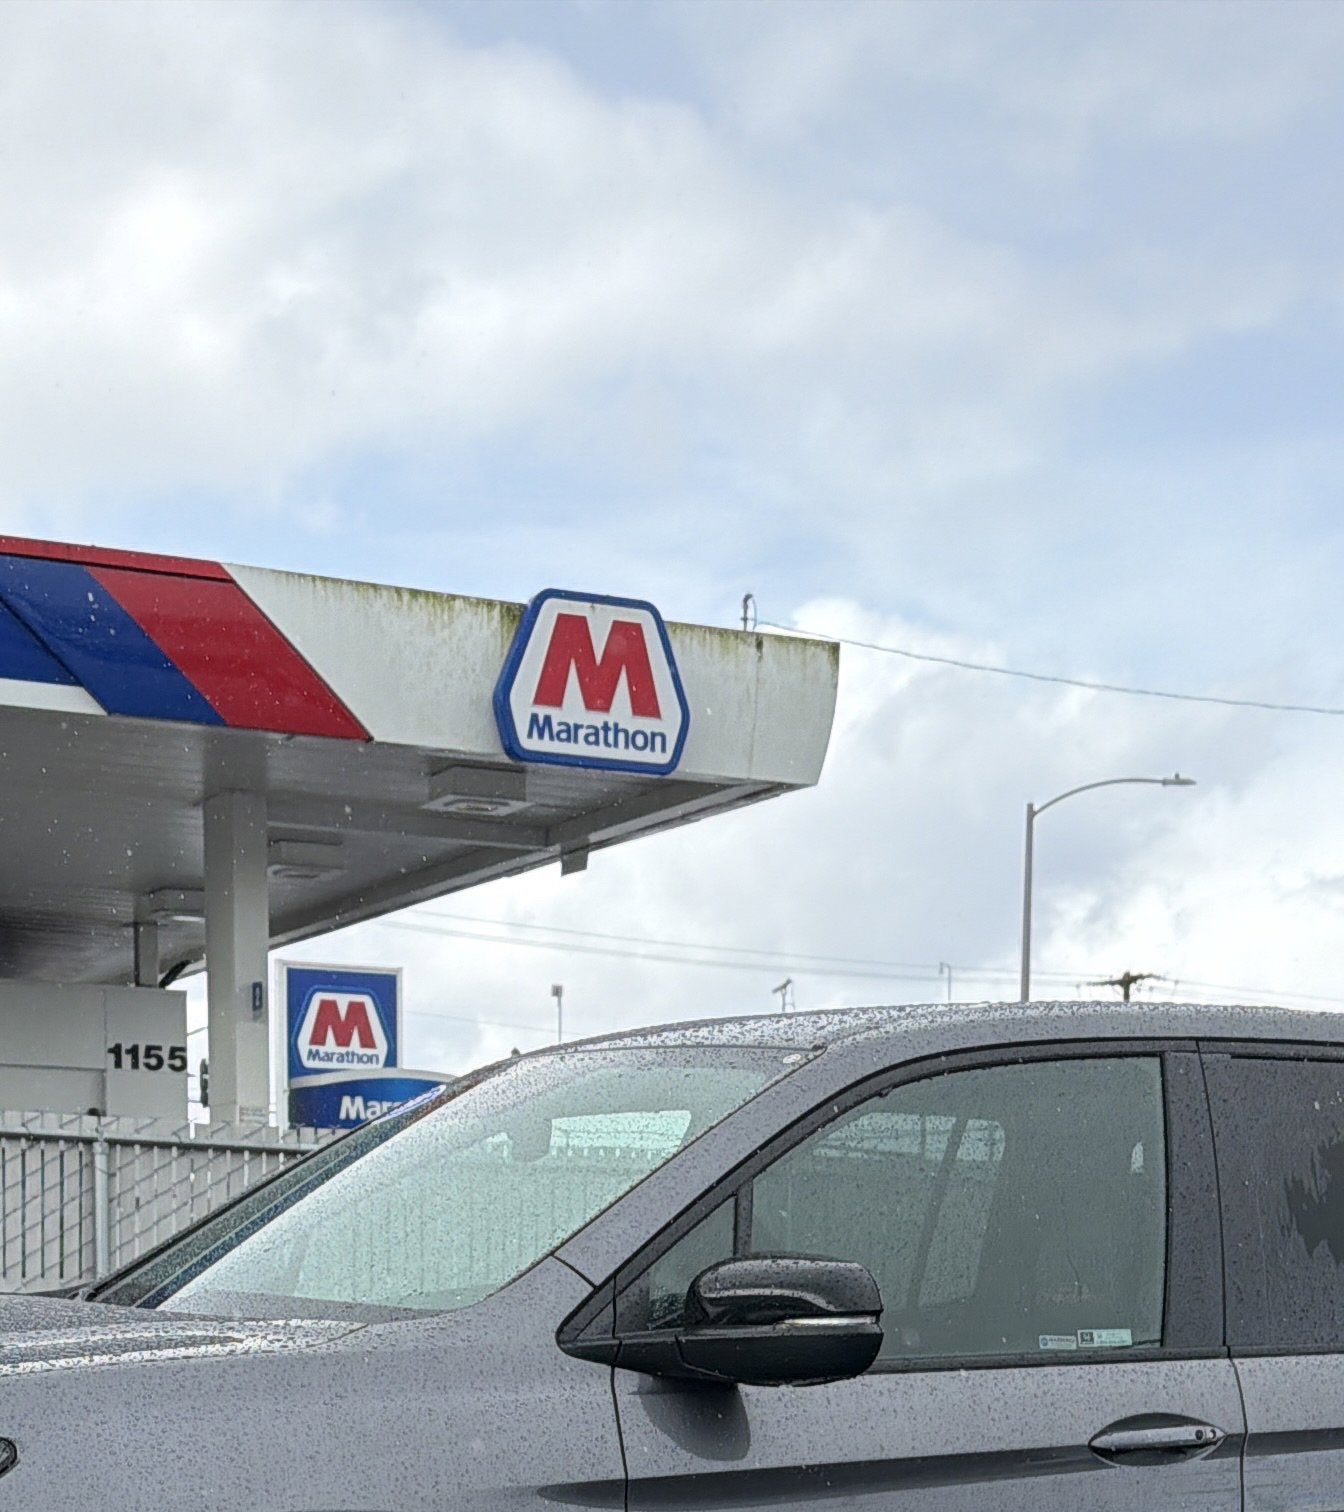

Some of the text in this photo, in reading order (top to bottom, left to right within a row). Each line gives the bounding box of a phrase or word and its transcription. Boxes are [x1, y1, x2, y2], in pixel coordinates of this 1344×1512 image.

[527, 713, 667, 754] Marathon
[107, 1042, 187, 1072] 1155
[306, 1048, 380, 1066] Marathon
